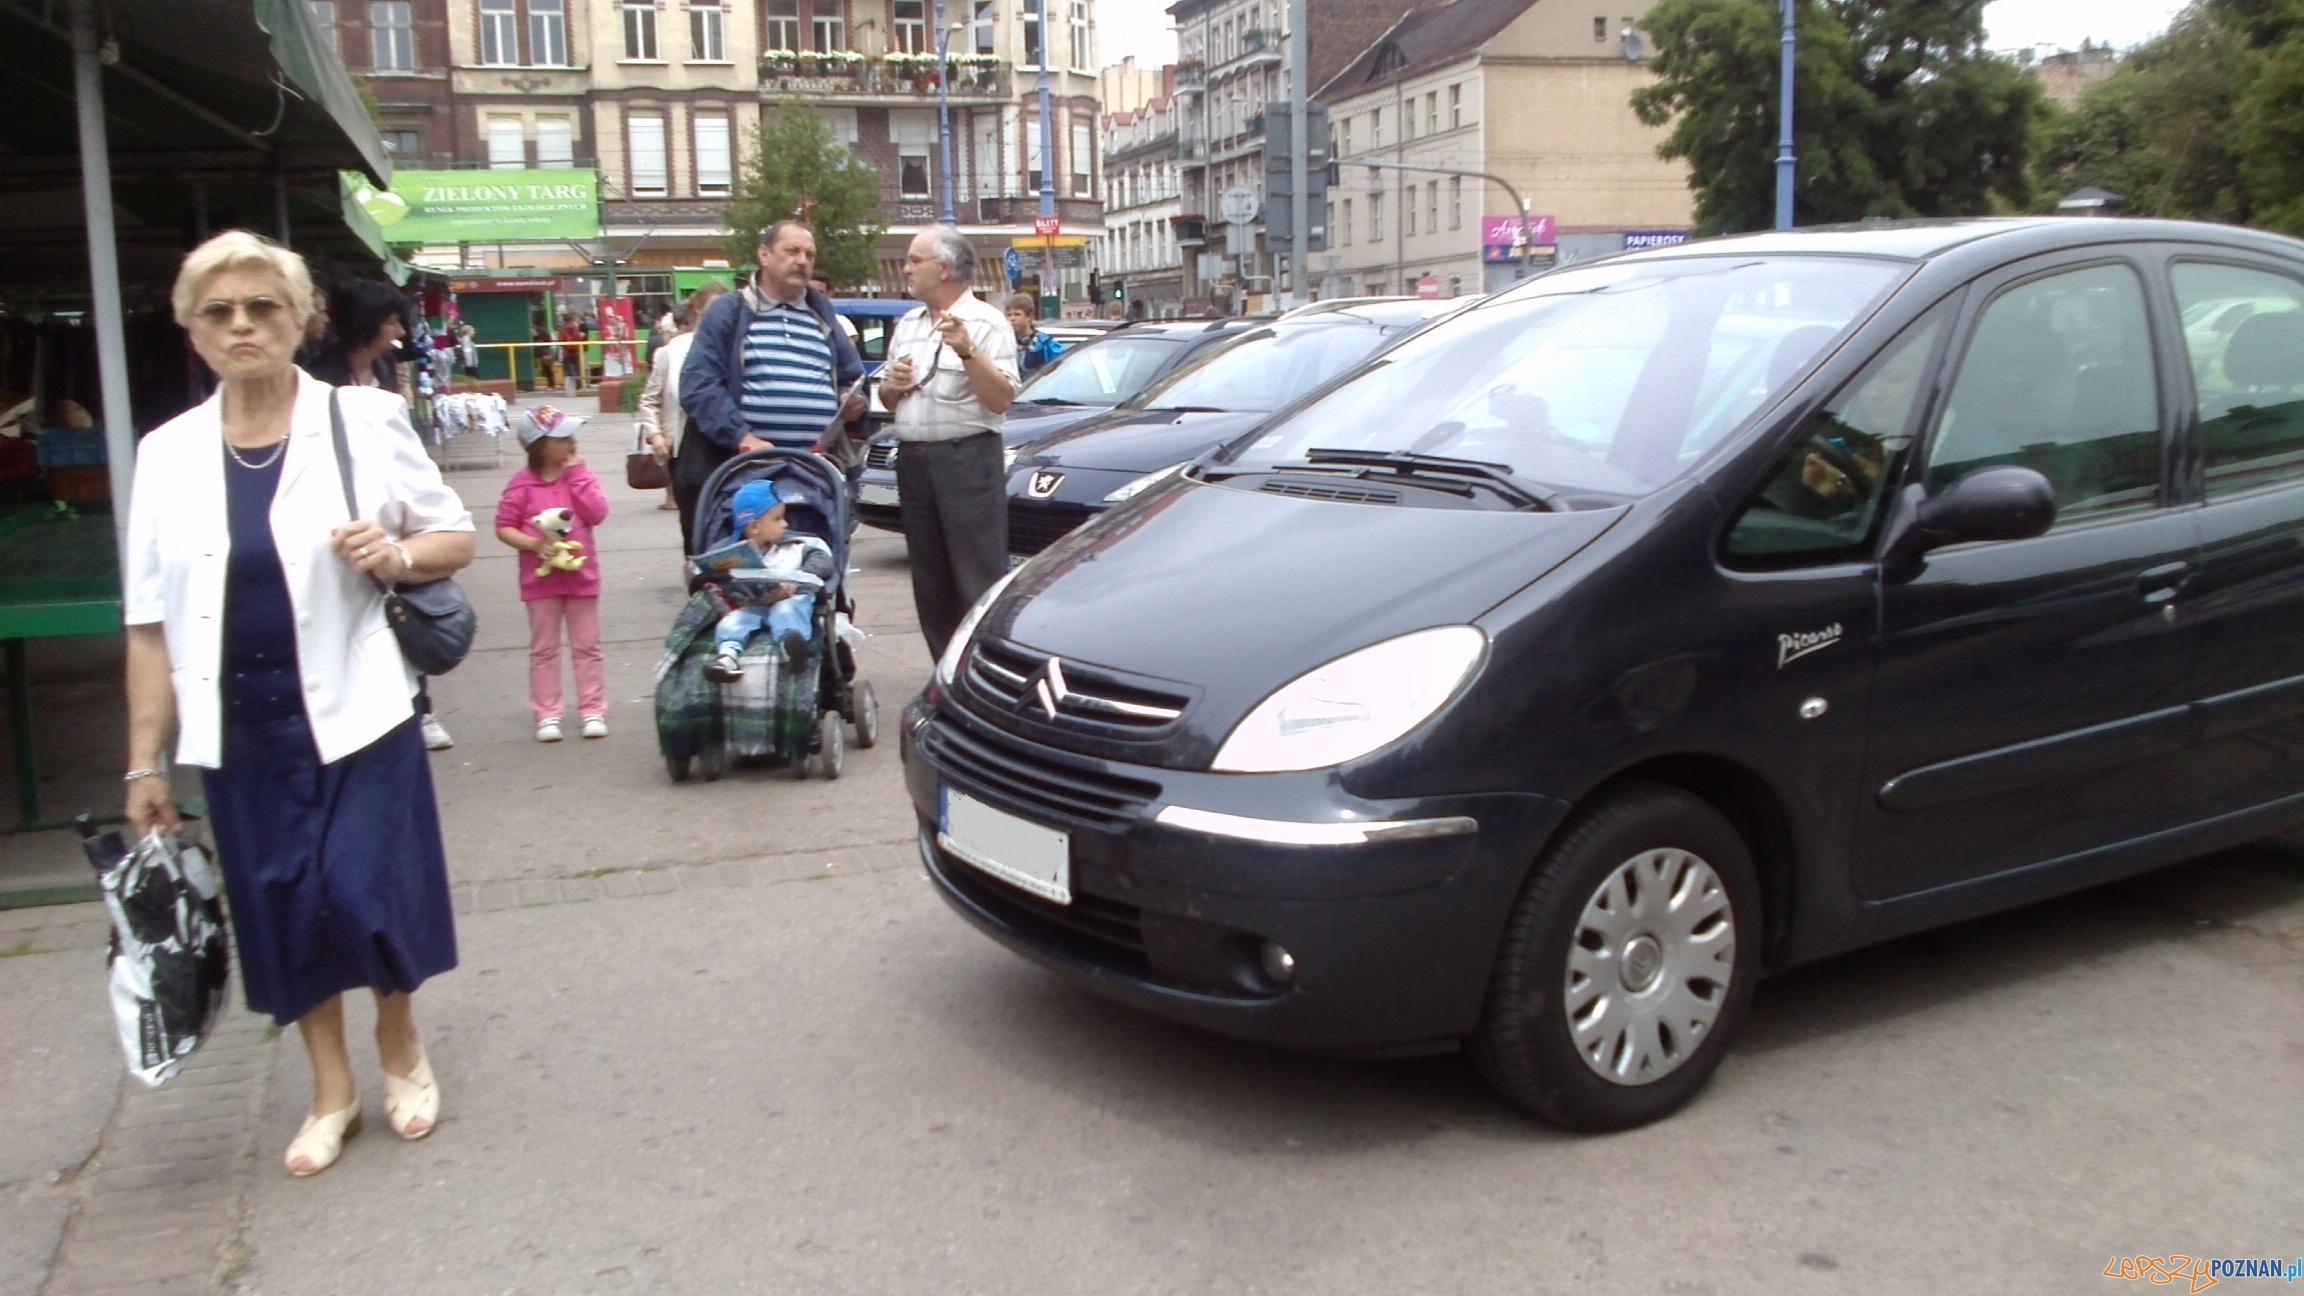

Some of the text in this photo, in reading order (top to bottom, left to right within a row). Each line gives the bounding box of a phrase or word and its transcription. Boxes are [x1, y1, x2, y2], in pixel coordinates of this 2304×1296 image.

[423, 184, 587, 201] ZIELONY TARG
[1626, 235, 1685, 247] PAPIEROSY
[1777, 622, 1843, 670] Picasso
